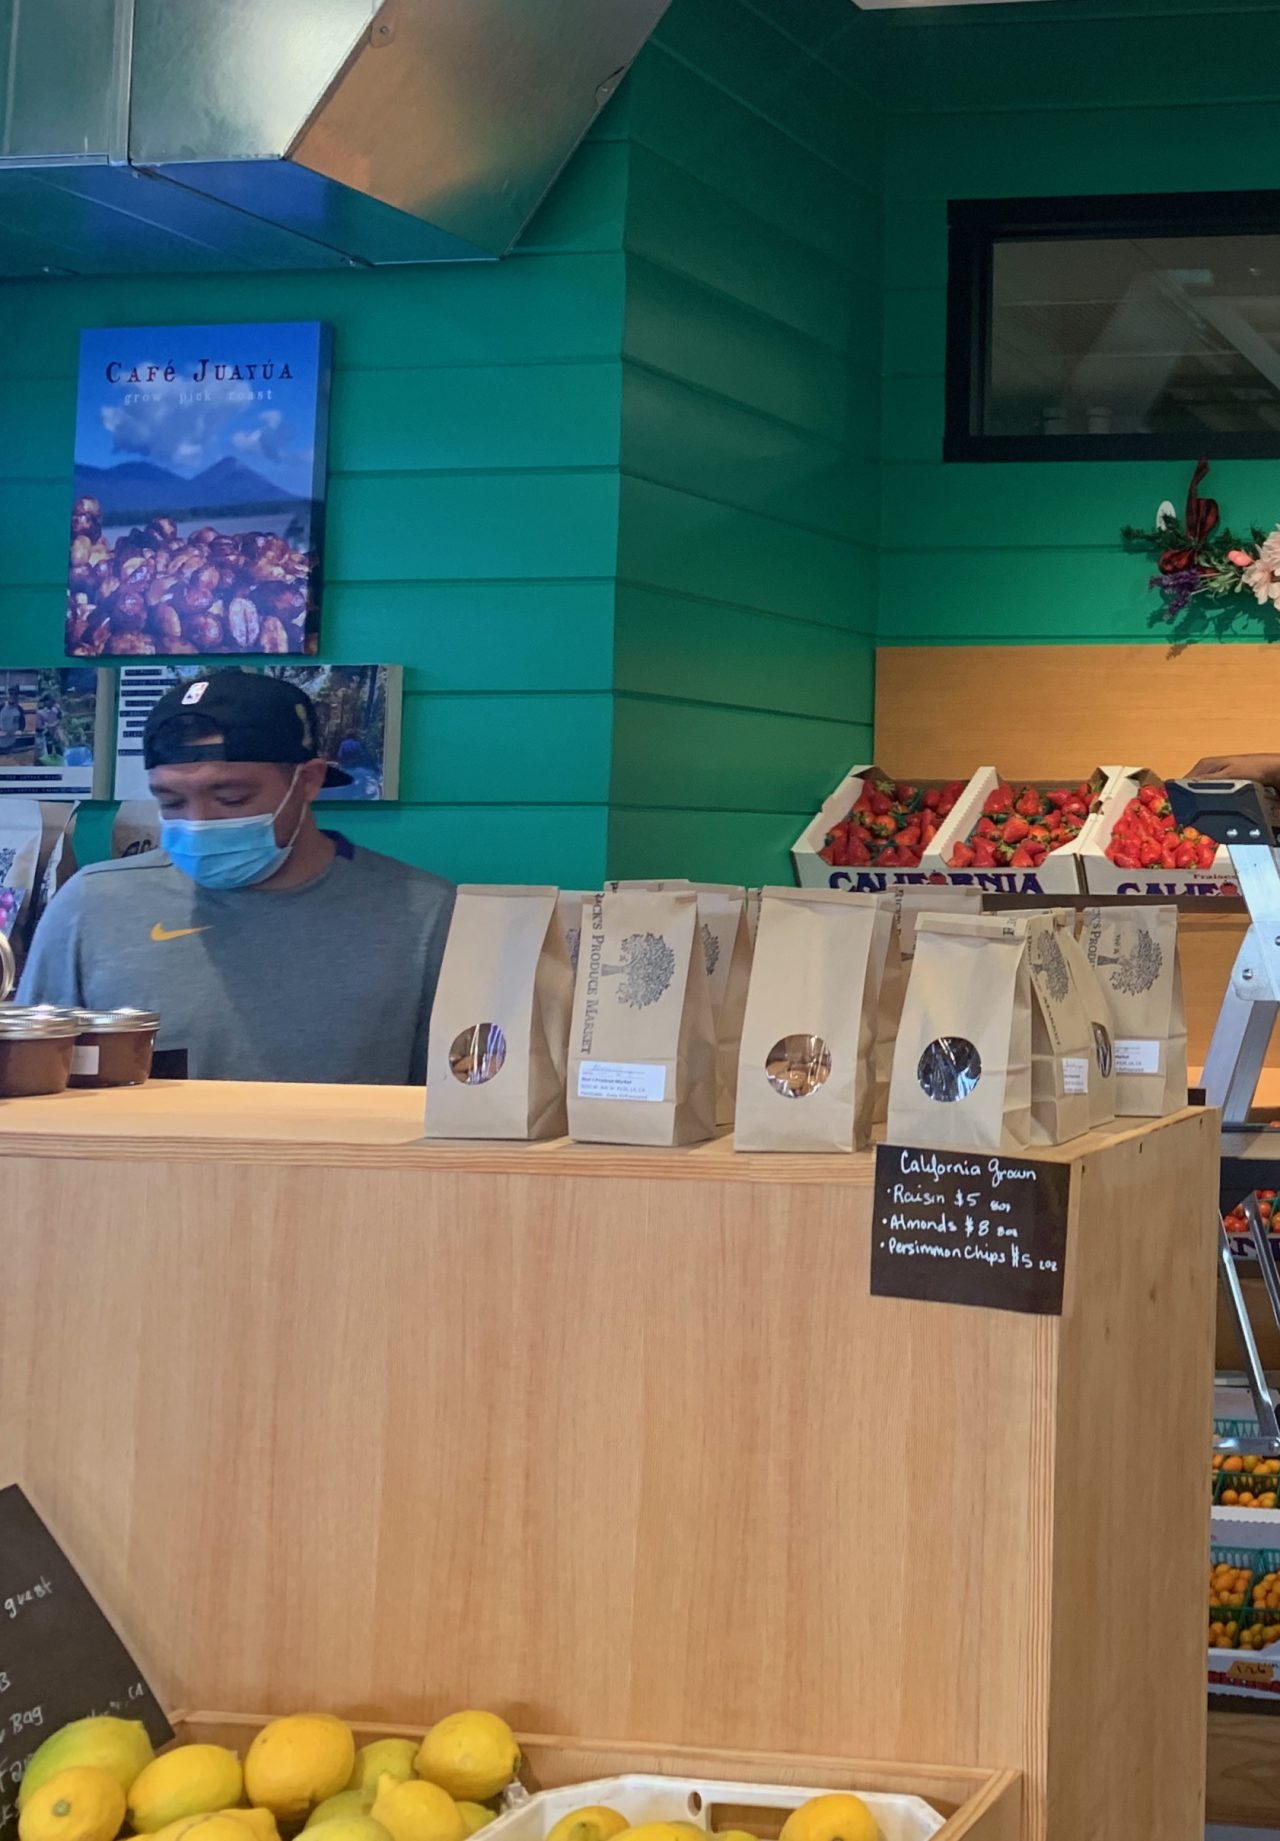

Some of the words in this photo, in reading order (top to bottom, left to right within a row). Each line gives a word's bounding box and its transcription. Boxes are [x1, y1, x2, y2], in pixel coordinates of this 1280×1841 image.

[124, 393, 161, 405] grow
[179, 390, 212, 404] pick
[229, 389, 273, 400] roast
[587, 934, 605, 995] PRODUCE
[581, 999, 600, 1054] MARKET
[900, 1149, 981, 1182] California
[893, 1183, 945, 1204] Raisin
[954, 1188, 981, 1207] $5
[890, 1212, 957, 1233] Almonds
[965, 1215, 990, 1237] $8
[964, 1243, 1006, 1267] Chips
[9, 1705, 44, 1735] Bag
